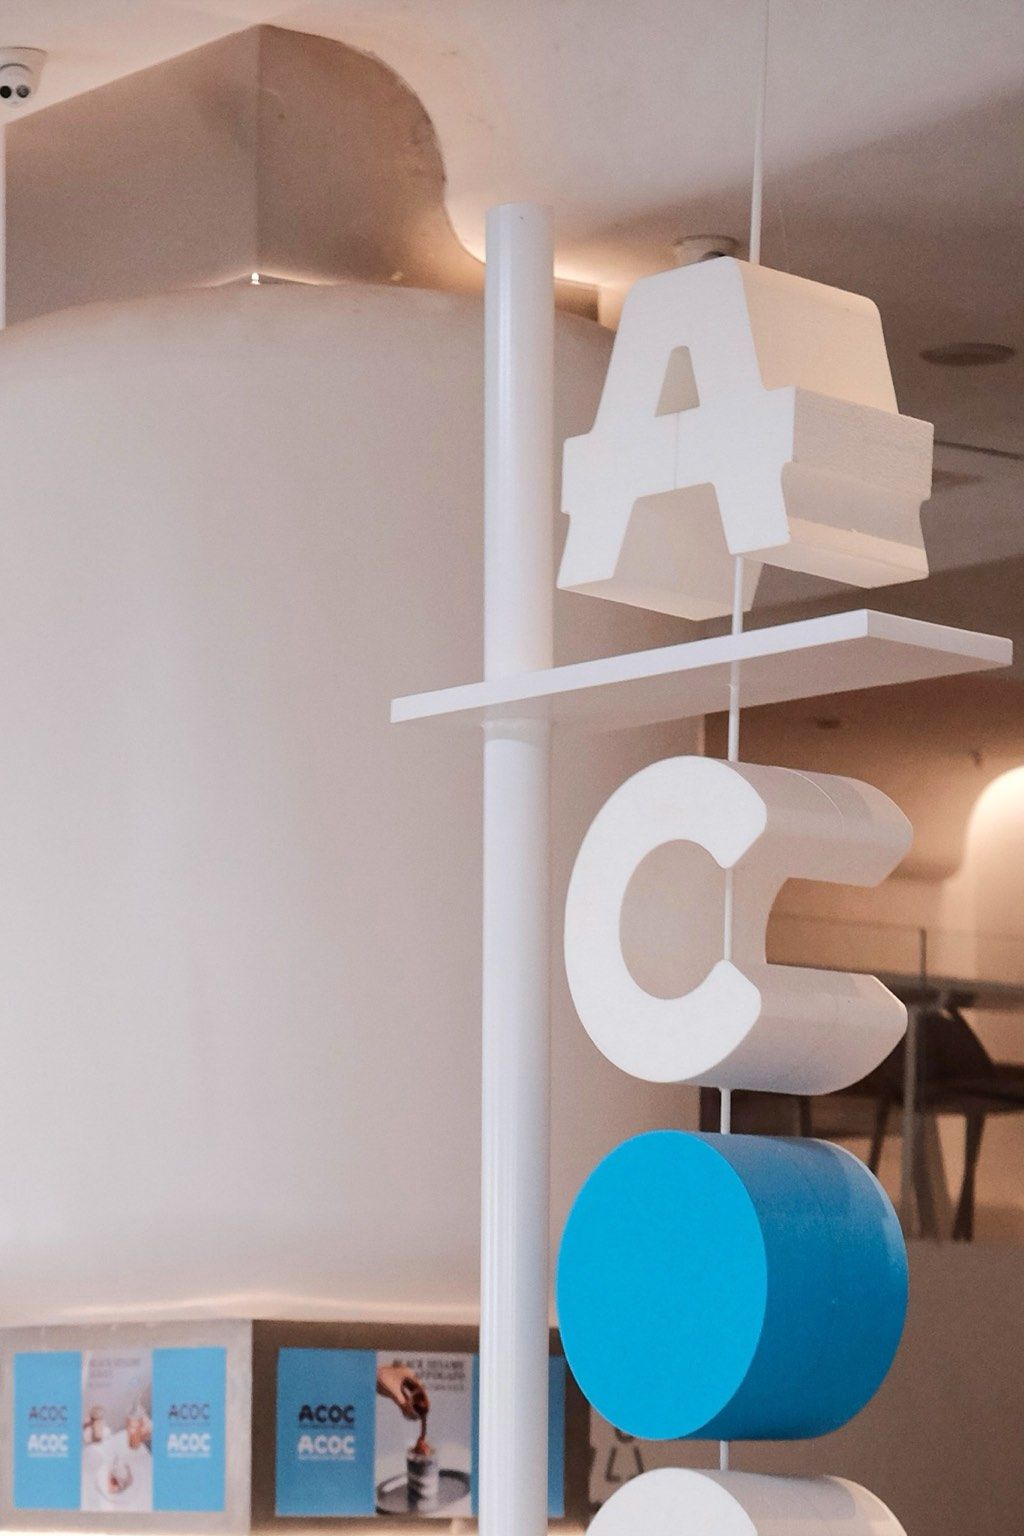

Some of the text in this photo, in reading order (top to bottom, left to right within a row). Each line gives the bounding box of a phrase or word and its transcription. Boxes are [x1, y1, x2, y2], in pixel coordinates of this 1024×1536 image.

[28, 1405, 68, 1422] ACOC
[168, 1404, 210, 1420] ACOC
[298, 1404, 355, 1423] ACOC
[28, 1433, 69, 1451] ACOC
[167, 1433, 211, 1451] ACOC
[297, 1434, 355, 1455] ACOC
